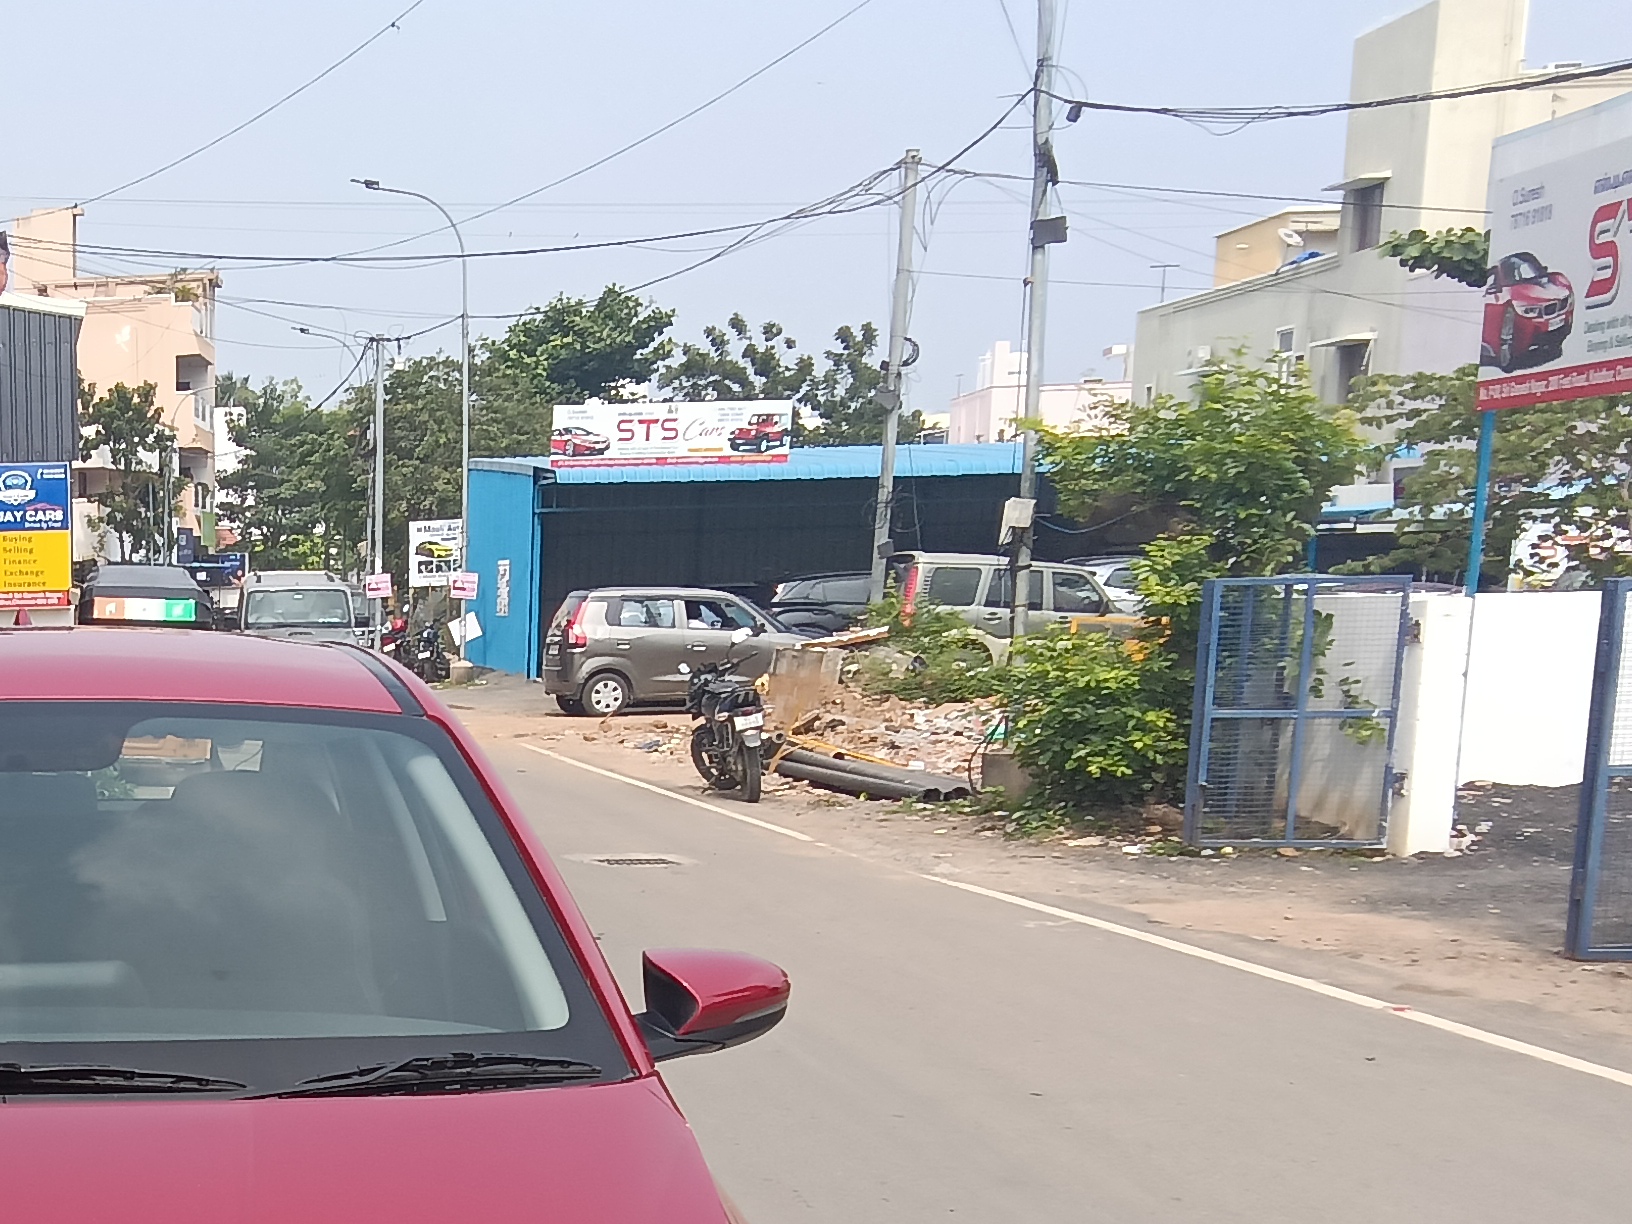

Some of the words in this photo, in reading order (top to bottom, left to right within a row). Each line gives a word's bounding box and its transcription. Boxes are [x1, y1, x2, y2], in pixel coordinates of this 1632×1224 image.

[617, 417, 679, 443] STS
[682, 417, 725, 443] Cars
[25, 509, 64, 522] CARS
[2, 534, 33, 544] Buying
[2, 546, 34, 555] Selling
[3, 557, 38, 566] Finance
[4, 569, 45, 578] Exchange
[3, 580, 47, 588] Insurance
